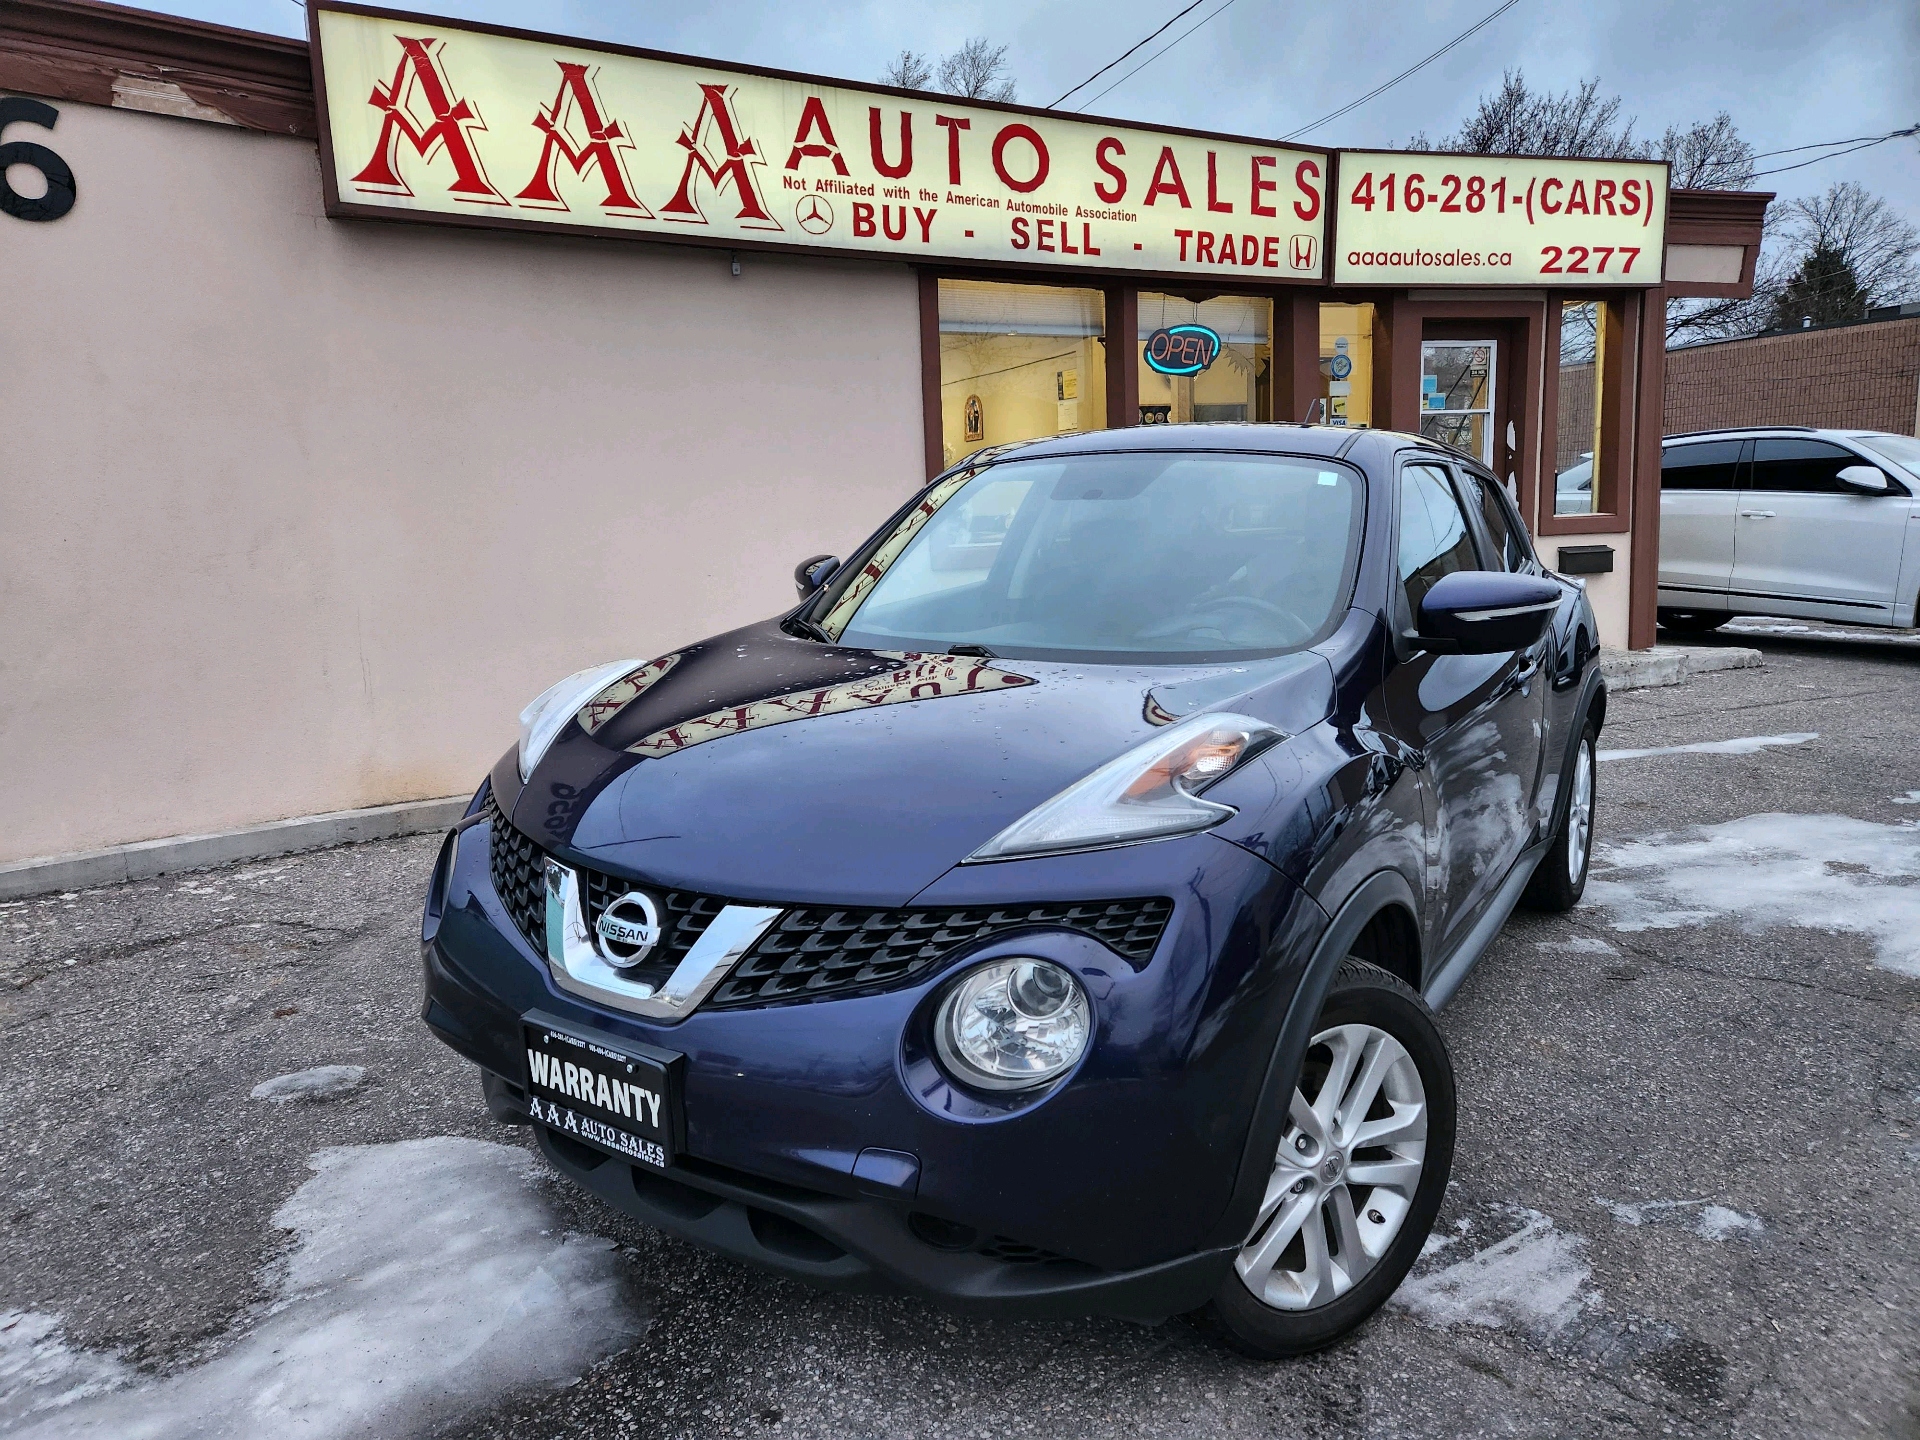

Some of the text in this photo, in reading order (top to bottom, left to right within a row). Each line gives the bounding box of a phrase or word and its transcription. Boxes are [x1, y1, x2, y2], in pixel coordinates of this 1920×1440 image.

[784, 97, 1050, 193] AUTO
[1095, 137, 1320, 222] SALES
[783, 176, 1137, 223] Not Affiliated with the American Automobile Association
[1351, 172, 1653, 227] 416-281-(CARS)
[853, 202, 937, 243] BUY
[1011, 217, 1101, 256] SELL
[1174, 229, 1280, 268] TRADE
[1347, 246, 1641, 274] aaaautosales.ca 2277
[1150, 332, 1214, 366] OPEN
[599, 921, 648, 942] NISSAN
[527, 1048, 661, 1129] WARRANTY
[581, 1118, 616, 1142] AUTO
[620, 1132, 665, 1161] SALES
[581, 1130, 665, 1168] www.aaaautosales.ca
